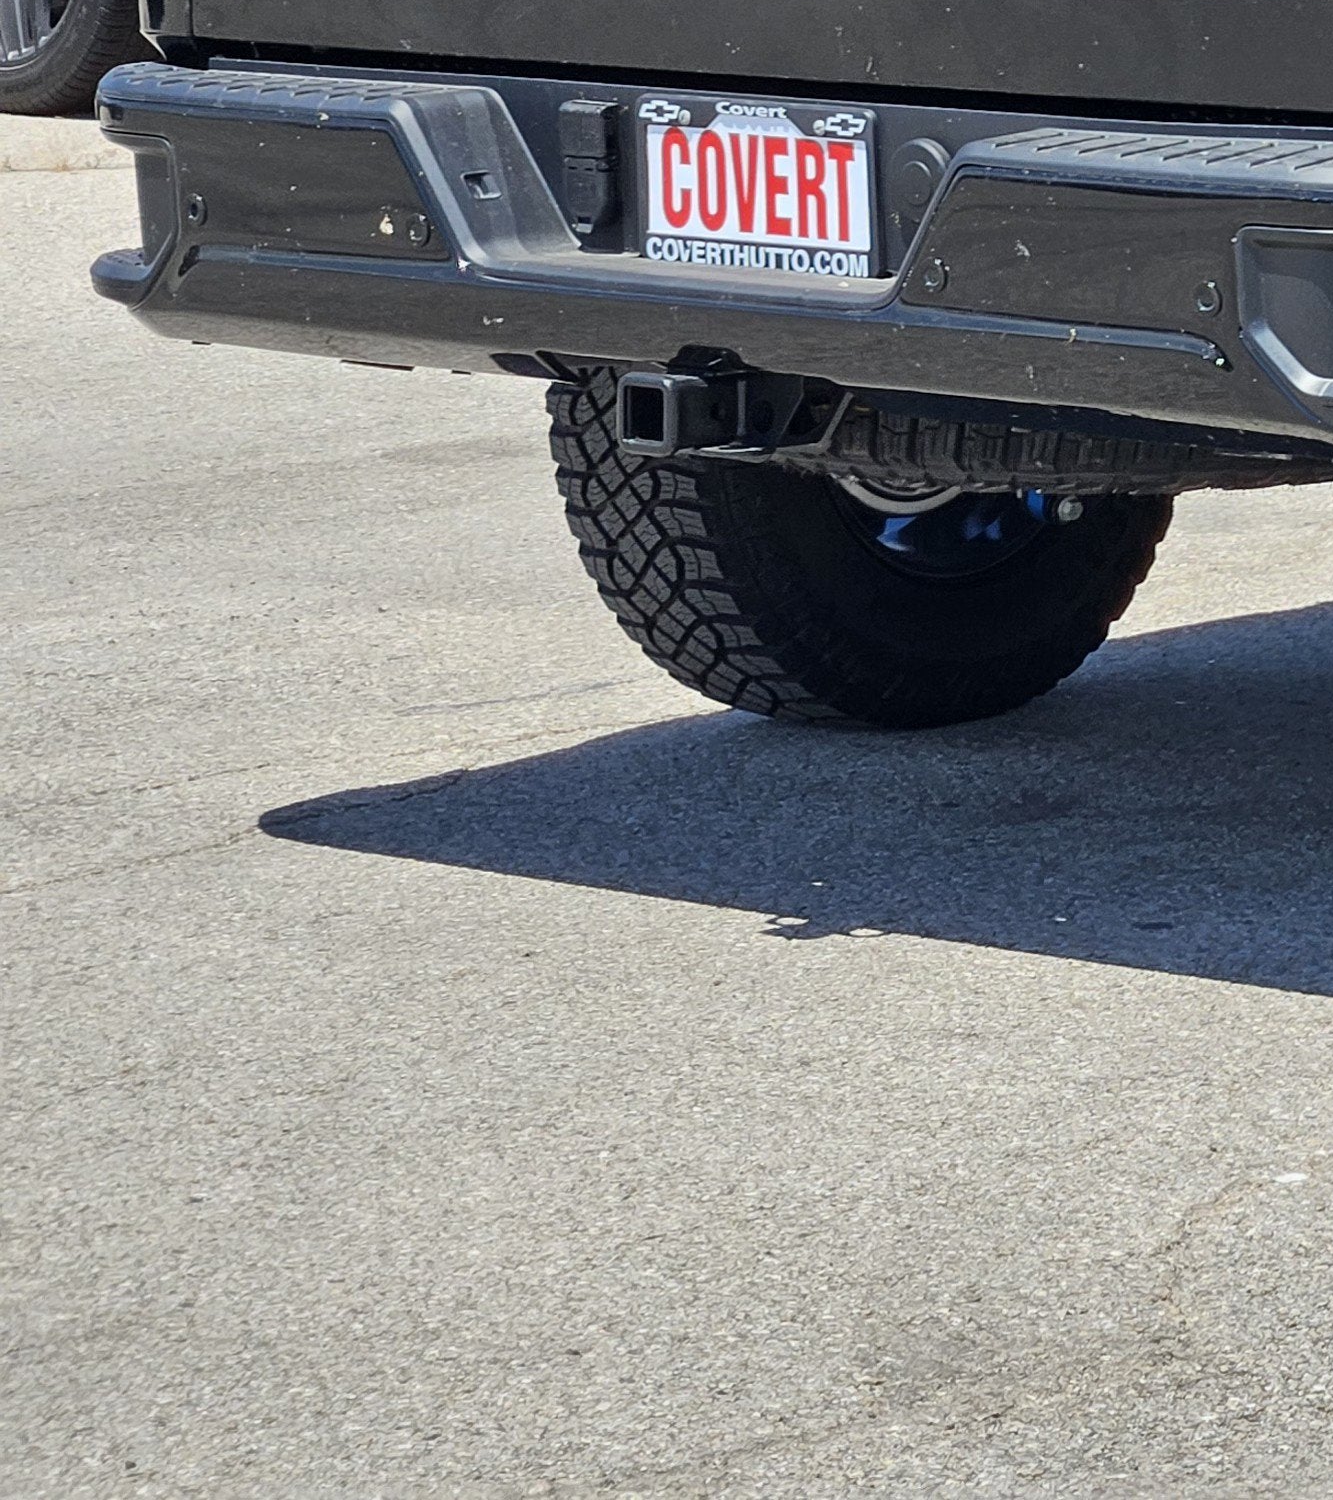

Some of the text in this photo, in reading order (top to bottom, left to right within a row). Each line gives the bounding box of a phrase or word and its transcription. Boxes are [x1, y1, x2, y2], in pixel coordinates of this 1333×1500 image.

[714, 101, 789, 120] Covert
[661, 125, 855, 242] COVERT
[645, 236, 869, 279] COVERTHUTTO.COM
